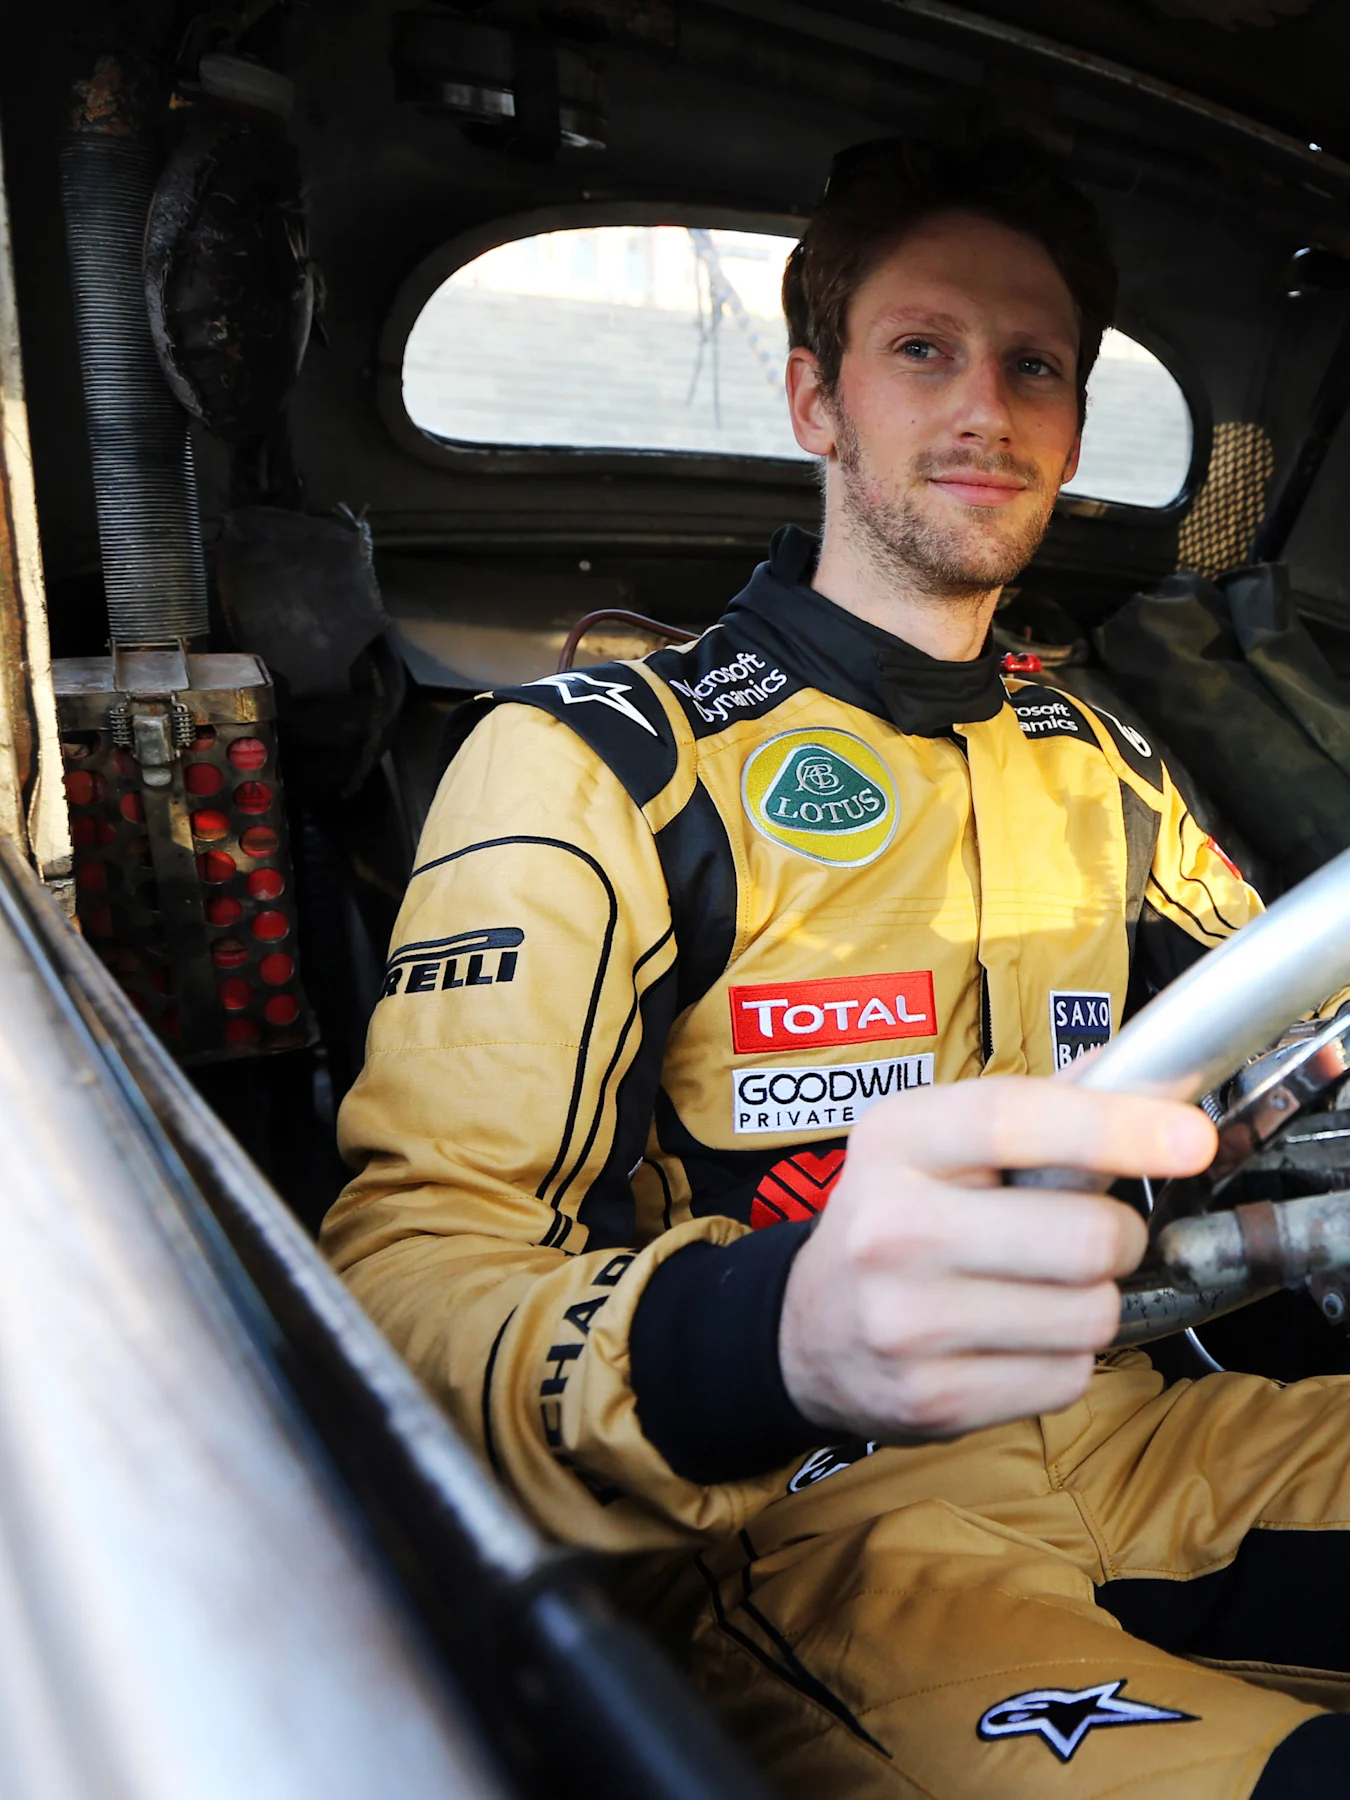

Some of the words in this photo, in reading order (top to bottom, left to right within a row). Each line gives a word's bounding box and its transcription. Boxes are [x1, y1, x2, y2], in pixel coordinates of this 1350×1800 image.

[1019, 715, 1079, 733] amics
[772, 788, 880, 823] LOTUS
[742, 994, 927, 1039] TOTAL
[1056, 1000, 1109, 1027] SAXO
[738, 1060, 931, 1106] GOODWILL
[739, 1106, 855, 1129] PRIVATE
